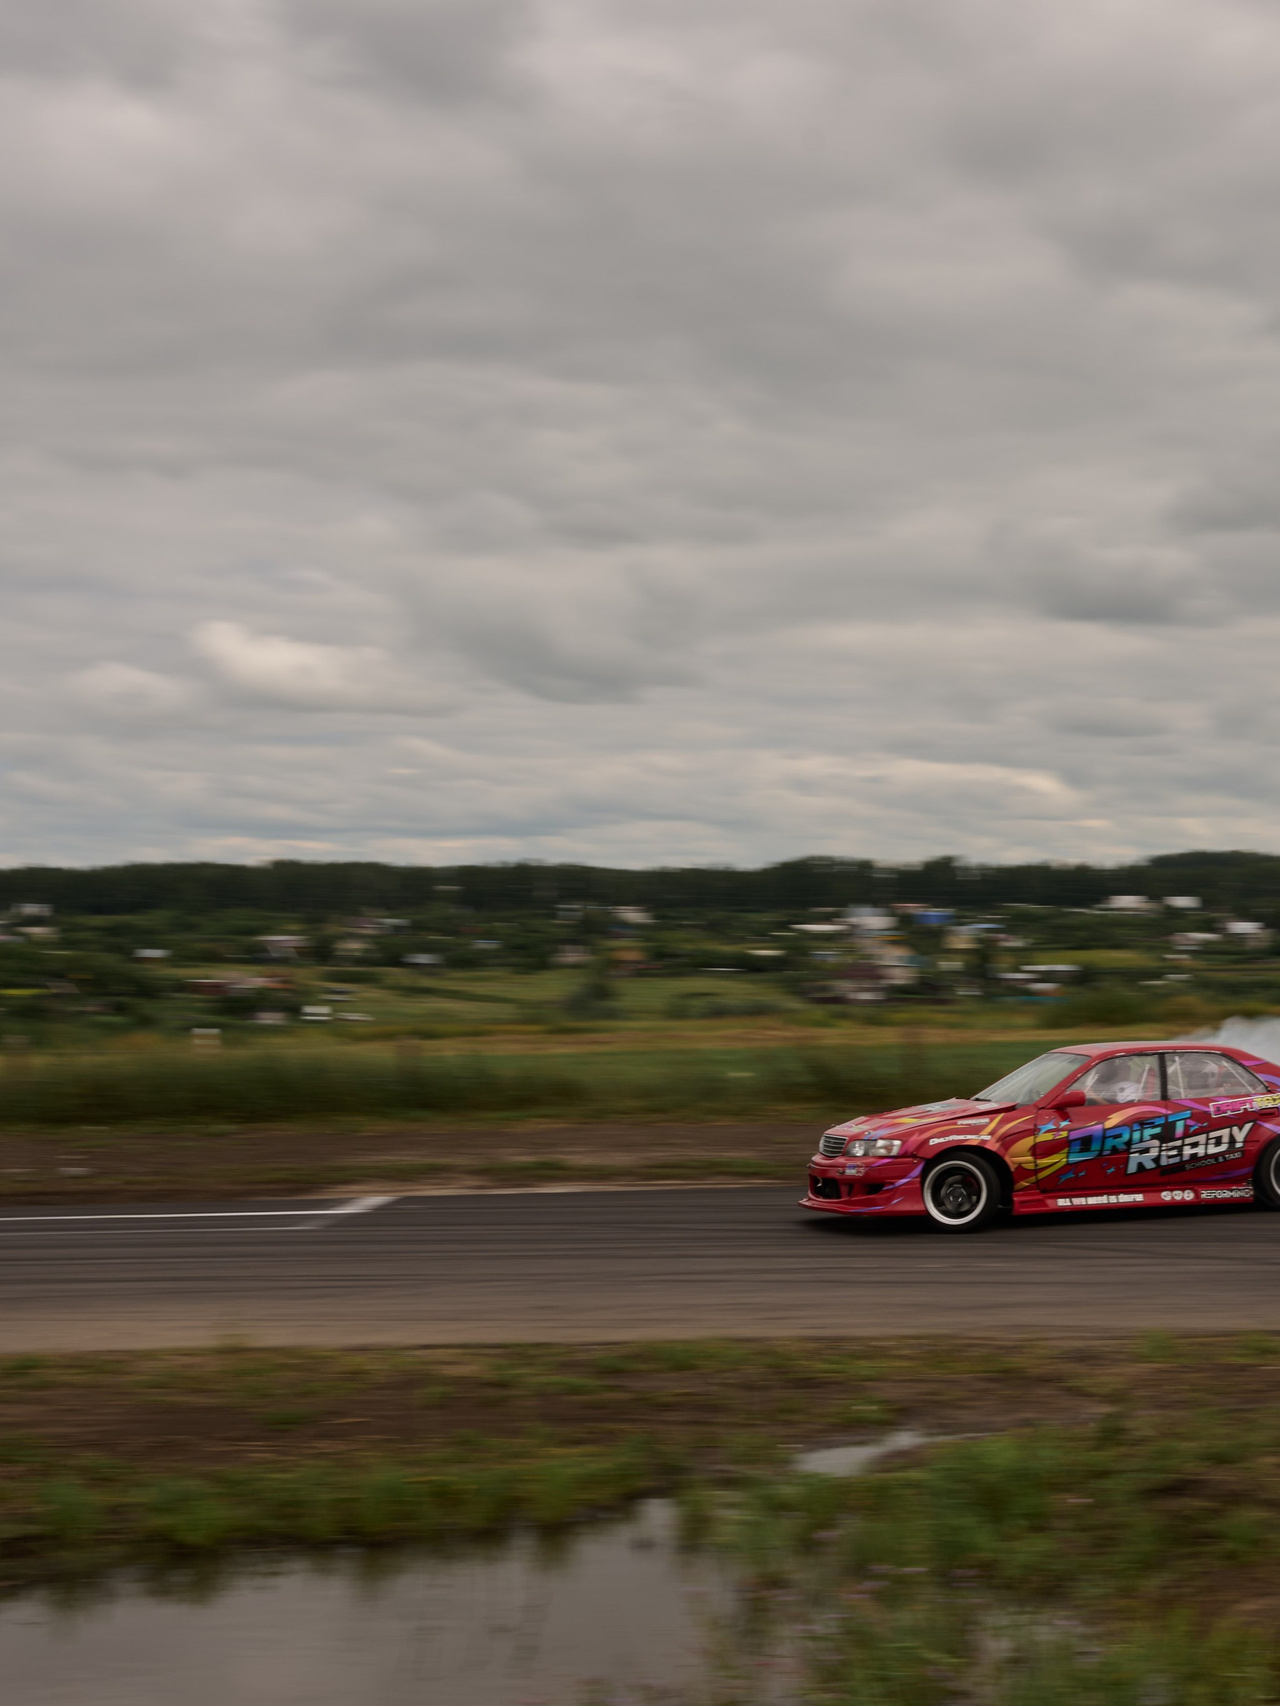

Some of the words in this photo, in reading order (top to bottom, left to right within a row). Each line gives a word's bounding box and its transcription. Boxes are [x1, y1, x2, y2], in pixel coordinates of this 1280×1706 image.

[1067, 1110, 1192, 1164] DRIFT
[1126, 1121, 1255, 1175] READY
[1185, 1158, 1217, 1170] SCHOOL
